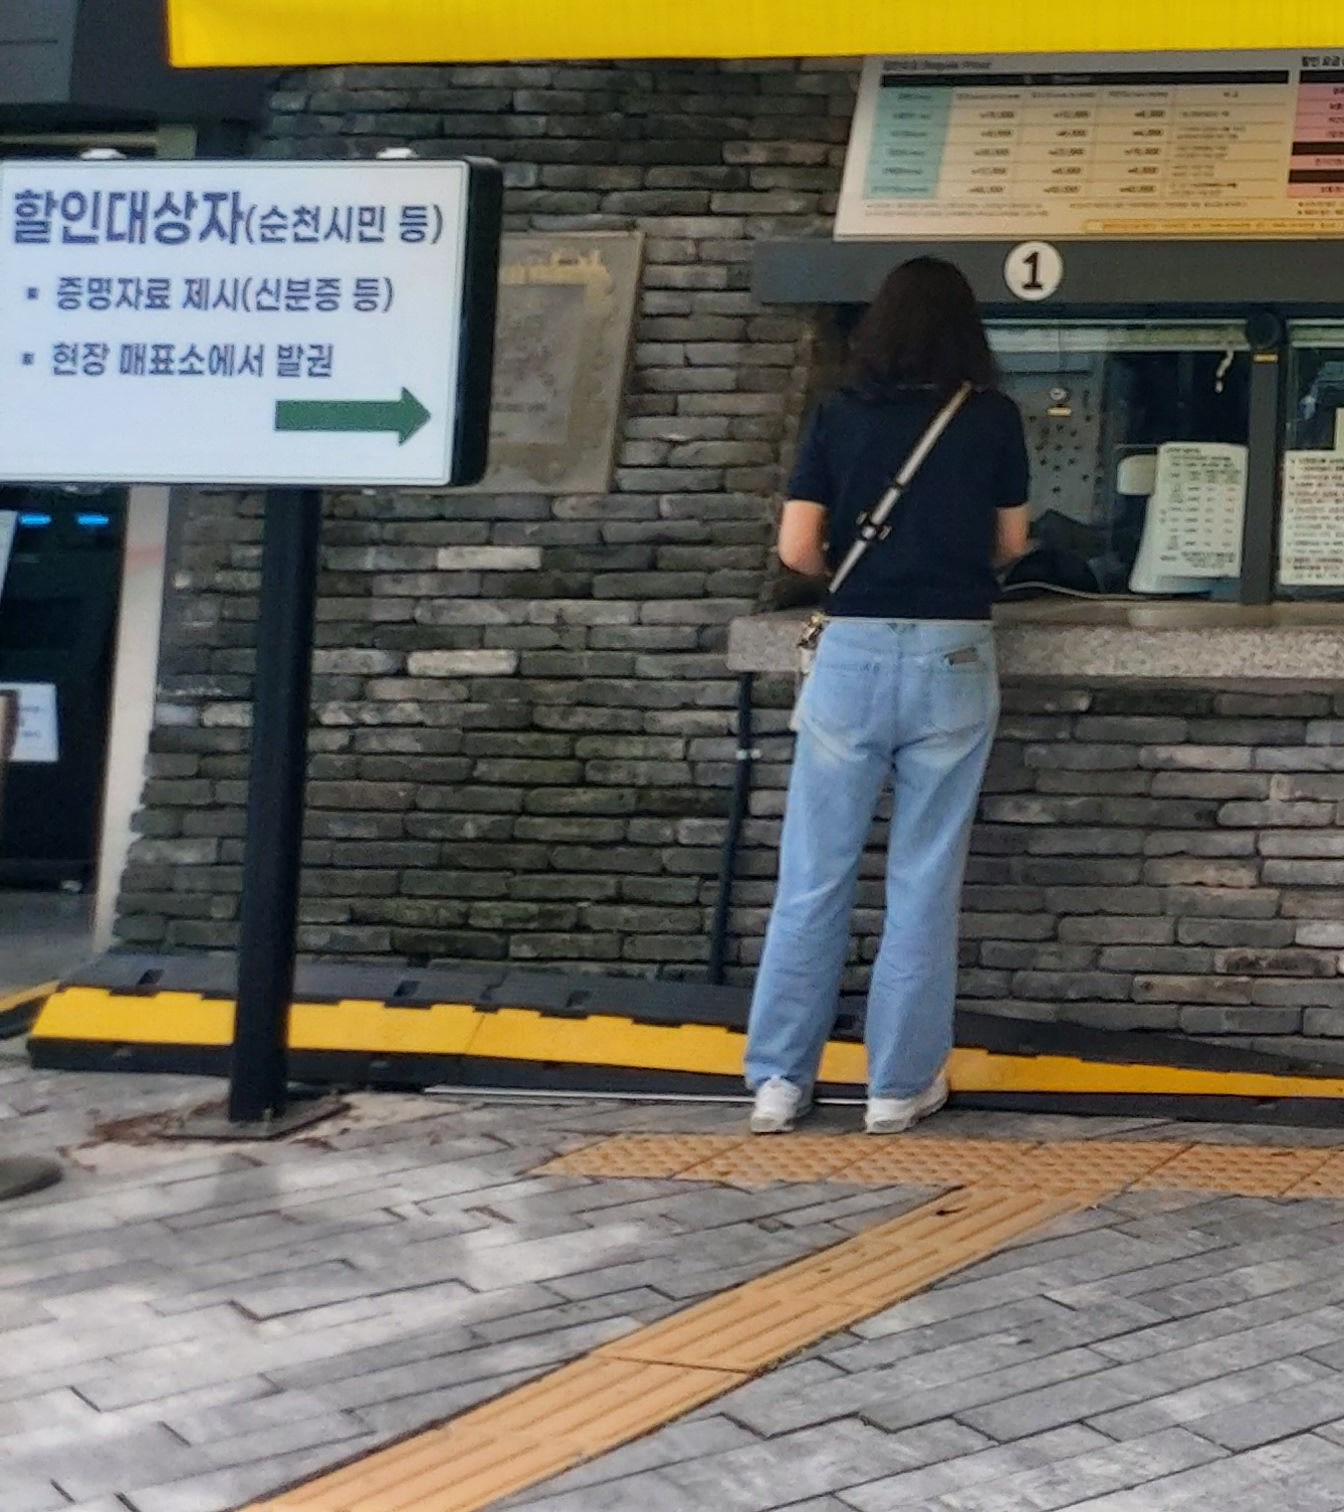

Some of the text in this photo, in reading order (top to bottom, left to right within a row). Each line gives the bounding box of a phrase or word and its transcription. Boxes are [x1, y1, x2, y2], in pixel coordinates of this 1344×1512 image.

[13, 189, 443, 246] 할인대상자(순천시민 등)
[1023, 251, 1043, 290] 1
[57, 276, 394, 313] 증명자료 제시(신분증 등)
[52, 343, 334, 378] 현장 매표소에서 발권
